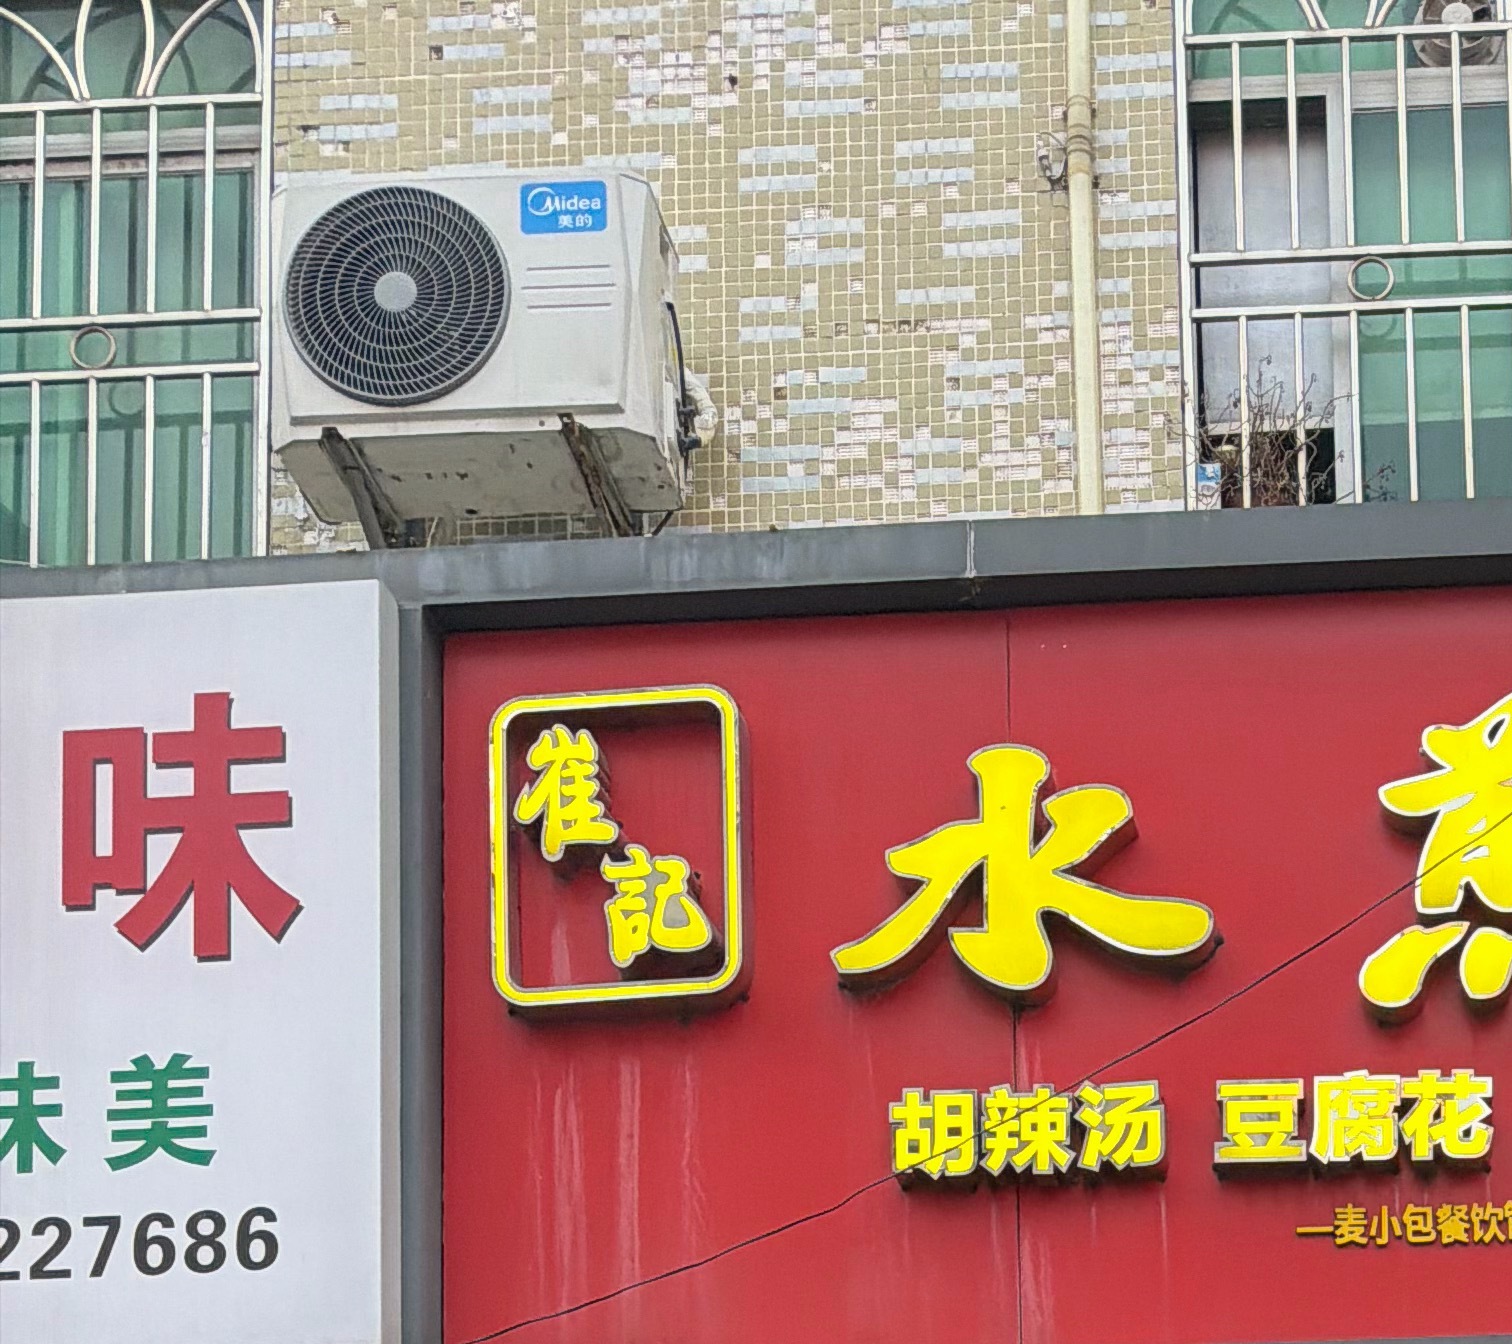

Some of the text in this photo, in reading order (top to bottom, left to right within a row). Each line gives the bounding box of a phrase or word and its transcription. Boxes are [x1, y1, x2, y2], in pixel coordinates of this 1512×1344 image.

[527, 187, 601, 216] Midea
[557, 213, 593, 228] 美的
[61, 692, 304, 962] 味
[889, 1079, 1168, 1177] 胡辣汤
[1213, 1068, 1497, 1166] 豆腐花
